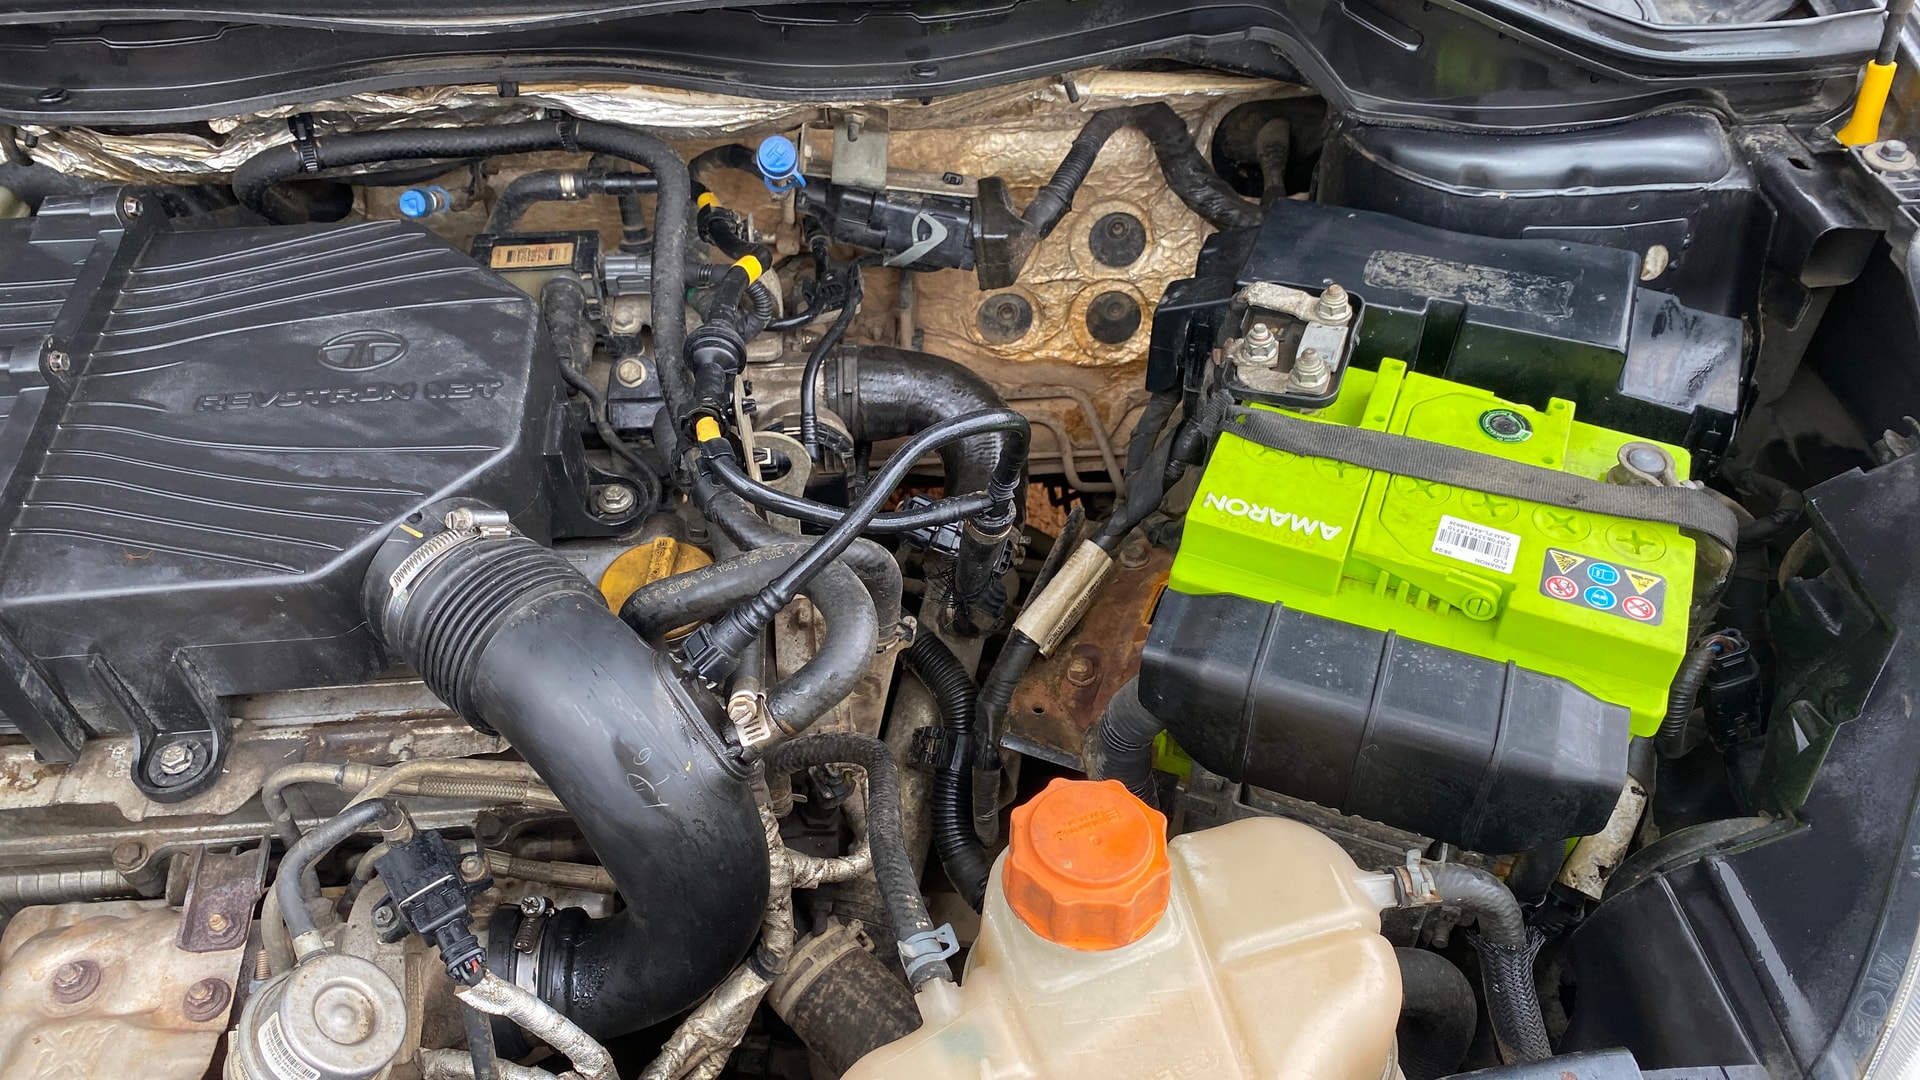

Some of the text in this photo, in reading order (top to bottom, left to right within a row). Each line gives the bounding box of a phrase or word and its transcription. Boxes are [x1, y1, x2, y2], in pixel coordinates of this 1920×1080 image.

[195, 382, 417, 411] REVOTRON
[1203, 492, 1343, 541] AMARON
[1474, 558, 1506, 571] AMARON
